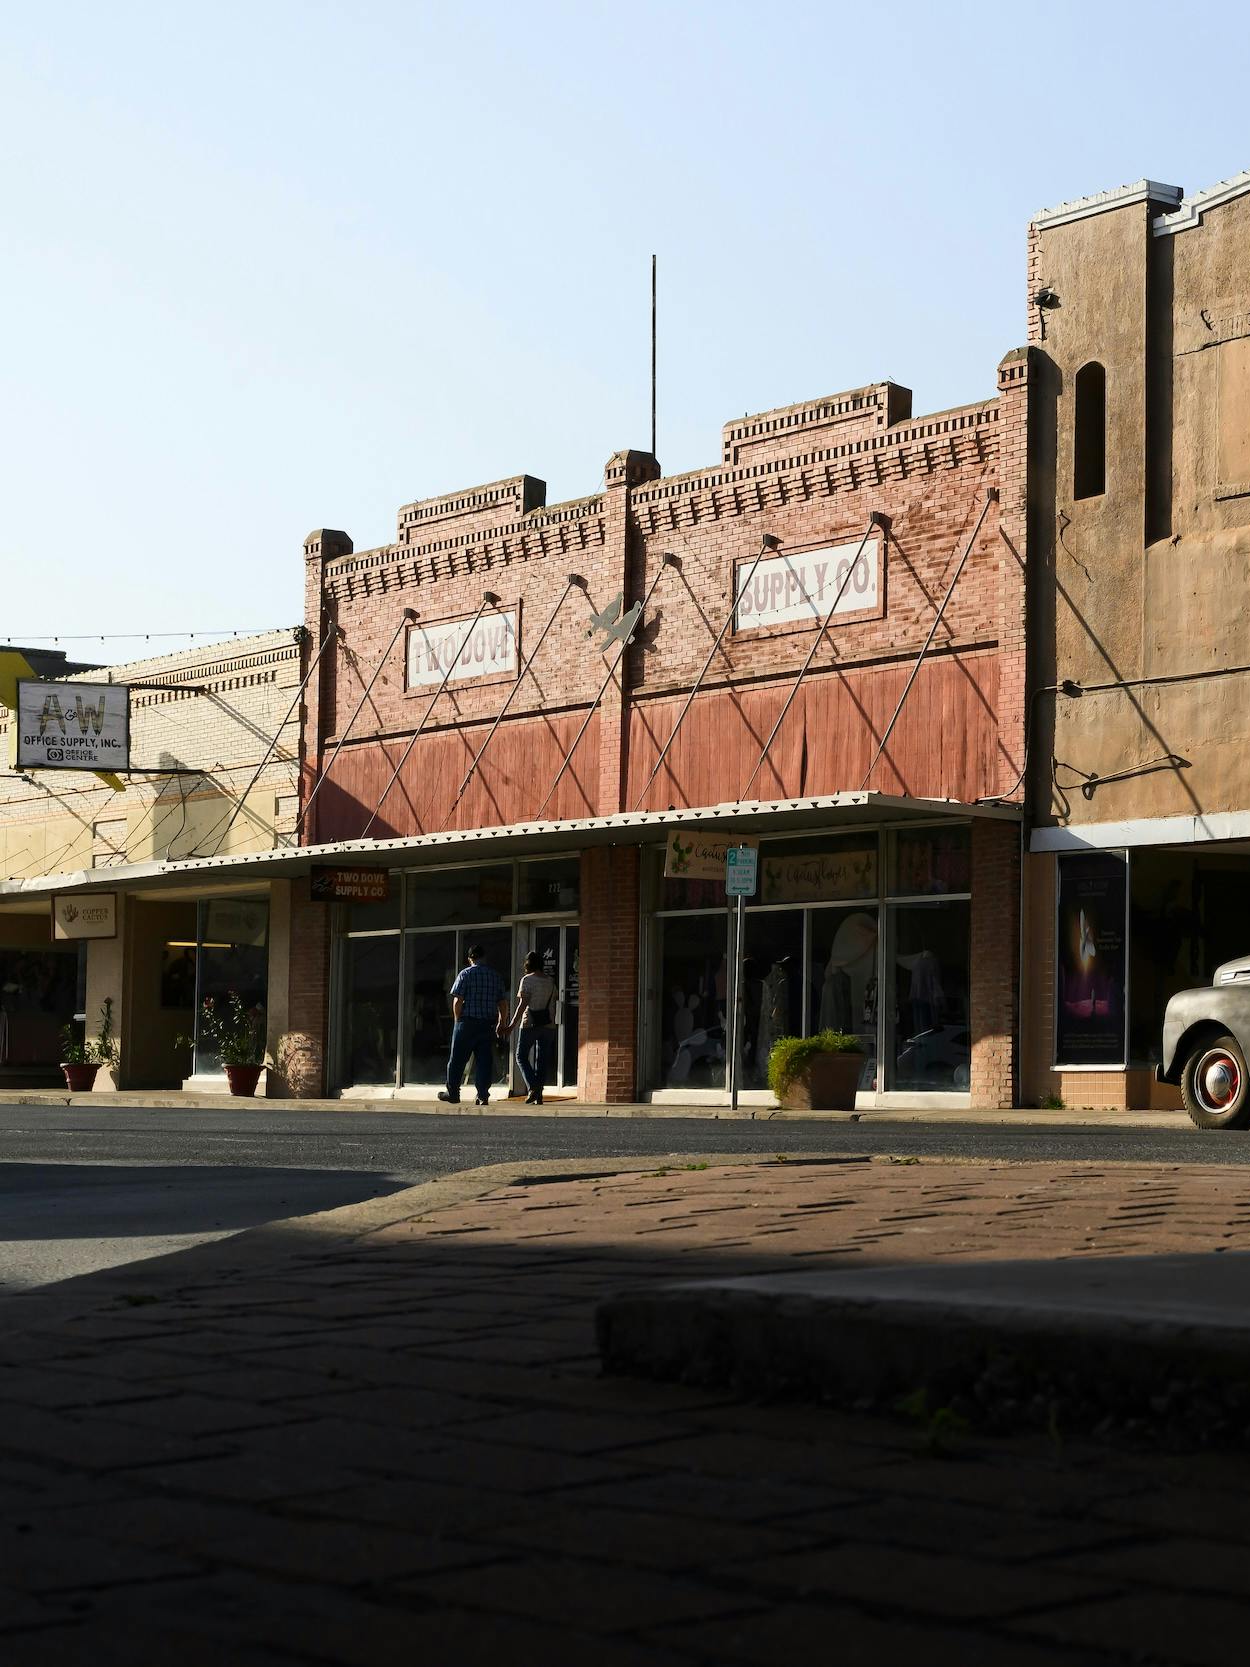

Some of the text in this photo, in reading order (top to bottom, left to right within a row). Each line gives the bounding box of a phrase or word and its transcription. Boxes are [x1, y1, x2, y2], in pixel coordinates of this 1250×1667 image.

[740, 556, 876, 615] SUPPLY CO.
[414, 624, 510, 674] TWO DOVE
[24, 735, 121, 749] OFFICE SUPPLY, INC.
[729, 852, 736, 864] 2
[336, 872, 385, 884] TWO DOVE
[335, 885, 386, 897] SUPPLY CO.
